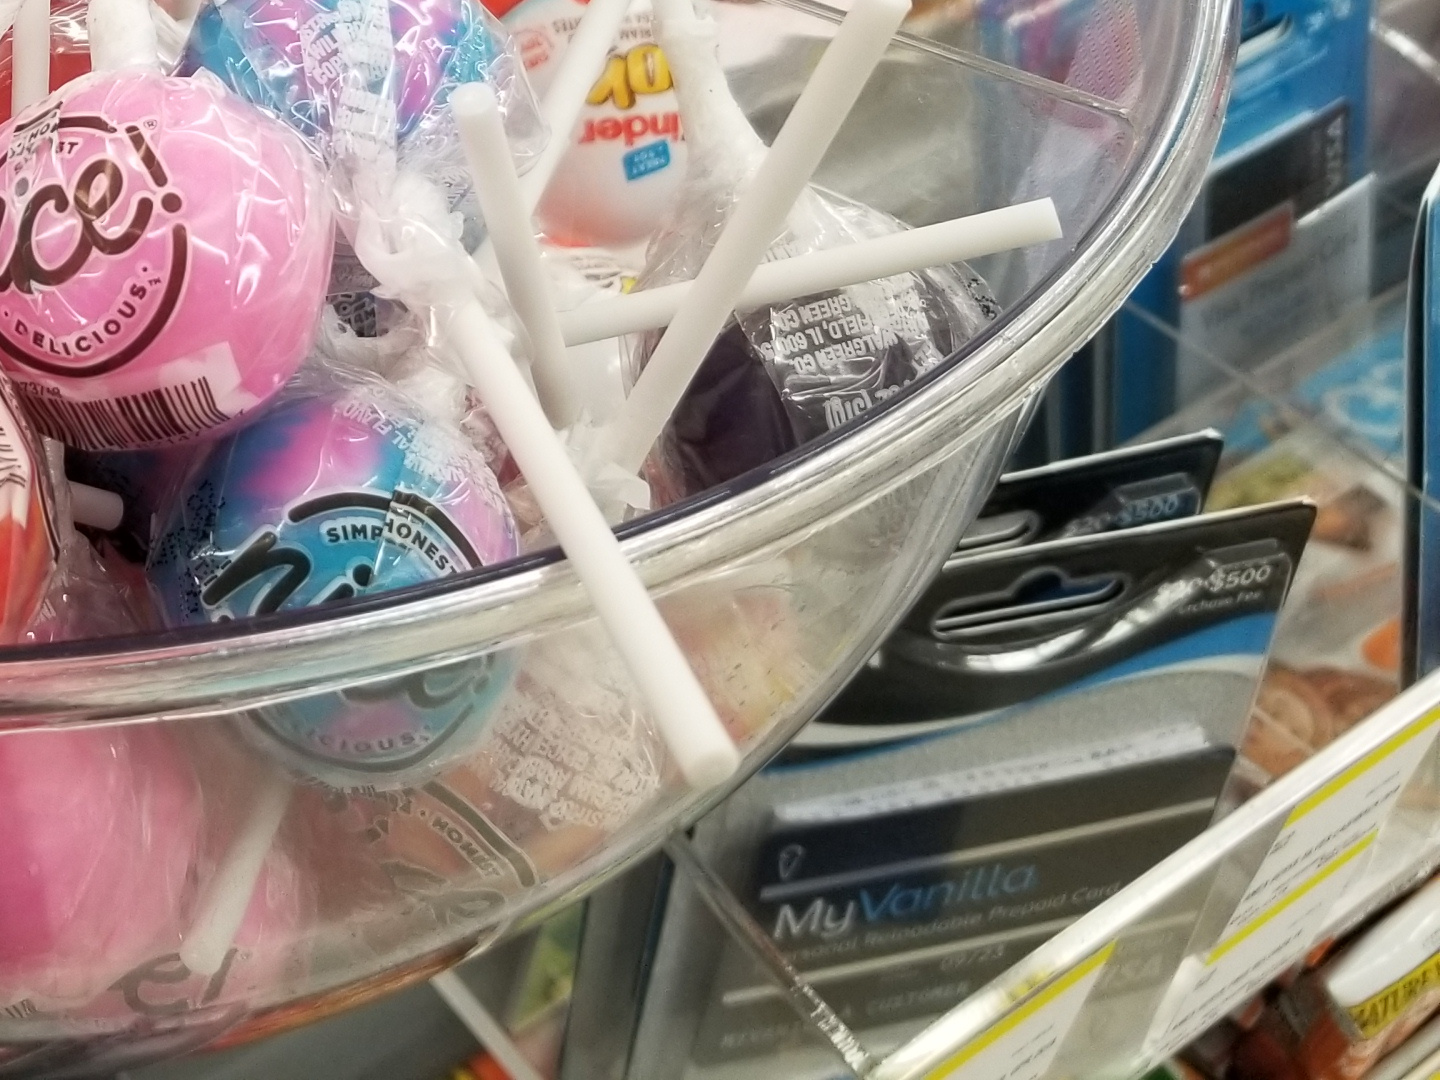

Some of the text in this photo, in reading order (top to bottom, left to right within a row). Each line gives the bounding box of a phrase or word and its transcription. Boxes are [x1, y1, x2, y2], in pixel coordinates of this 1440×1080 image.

[577, 113, 680, 146] inder
[4, 282, 148, 357] DELICIOUS
[799, 294, 851, 322] GREEN
[773, 860, 1039, 941] MyVanilla
